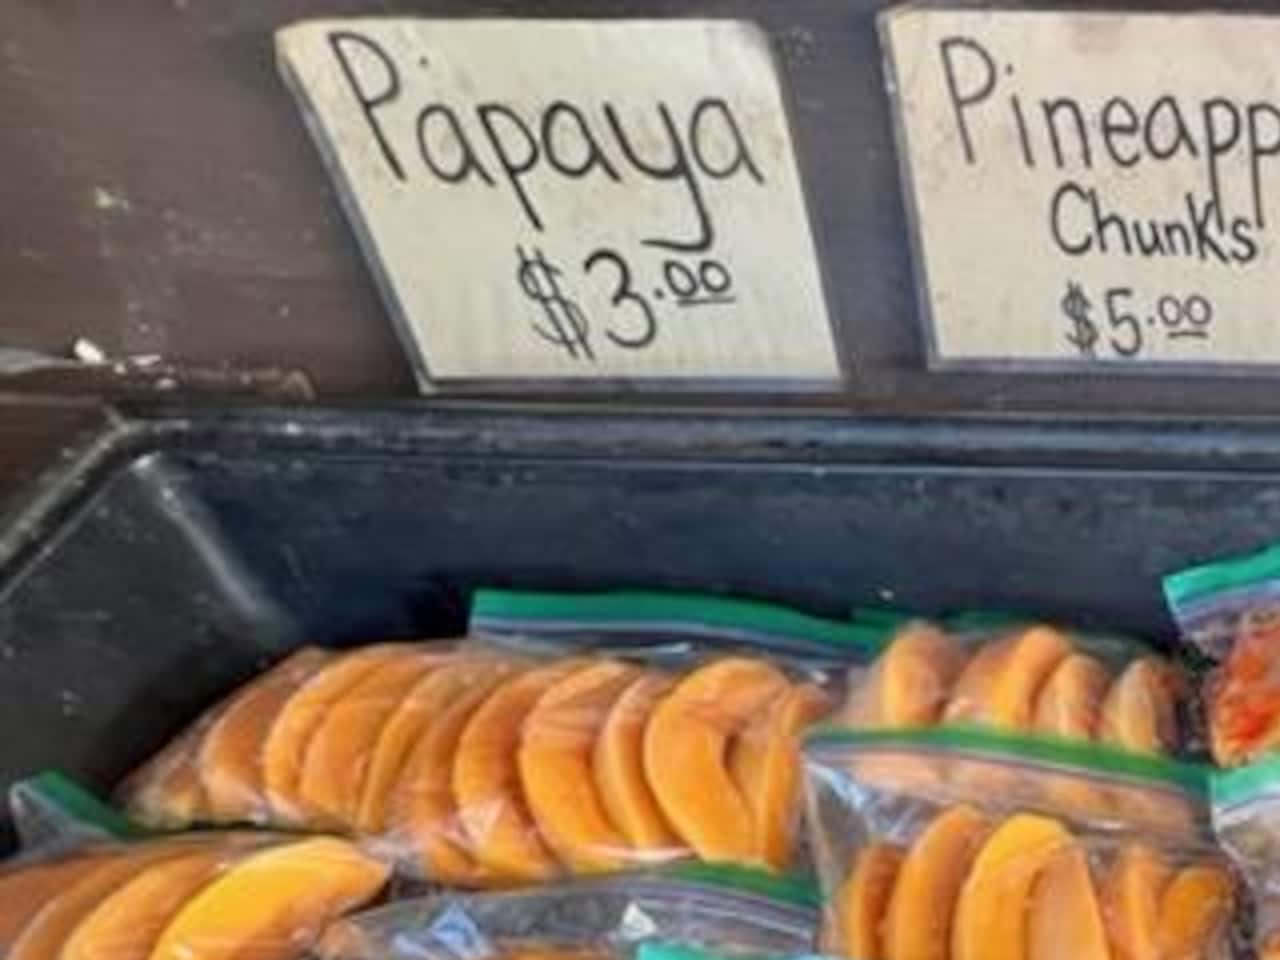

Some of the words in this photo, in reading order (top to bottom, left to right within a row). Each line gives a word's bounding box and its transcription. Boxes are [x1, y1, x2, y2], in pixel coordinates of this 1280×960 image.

[329, 31, 764, 252] Papaya
[517, 245, 736, 360] $3.00
[1061, 280, 1213, 357] $5.00
